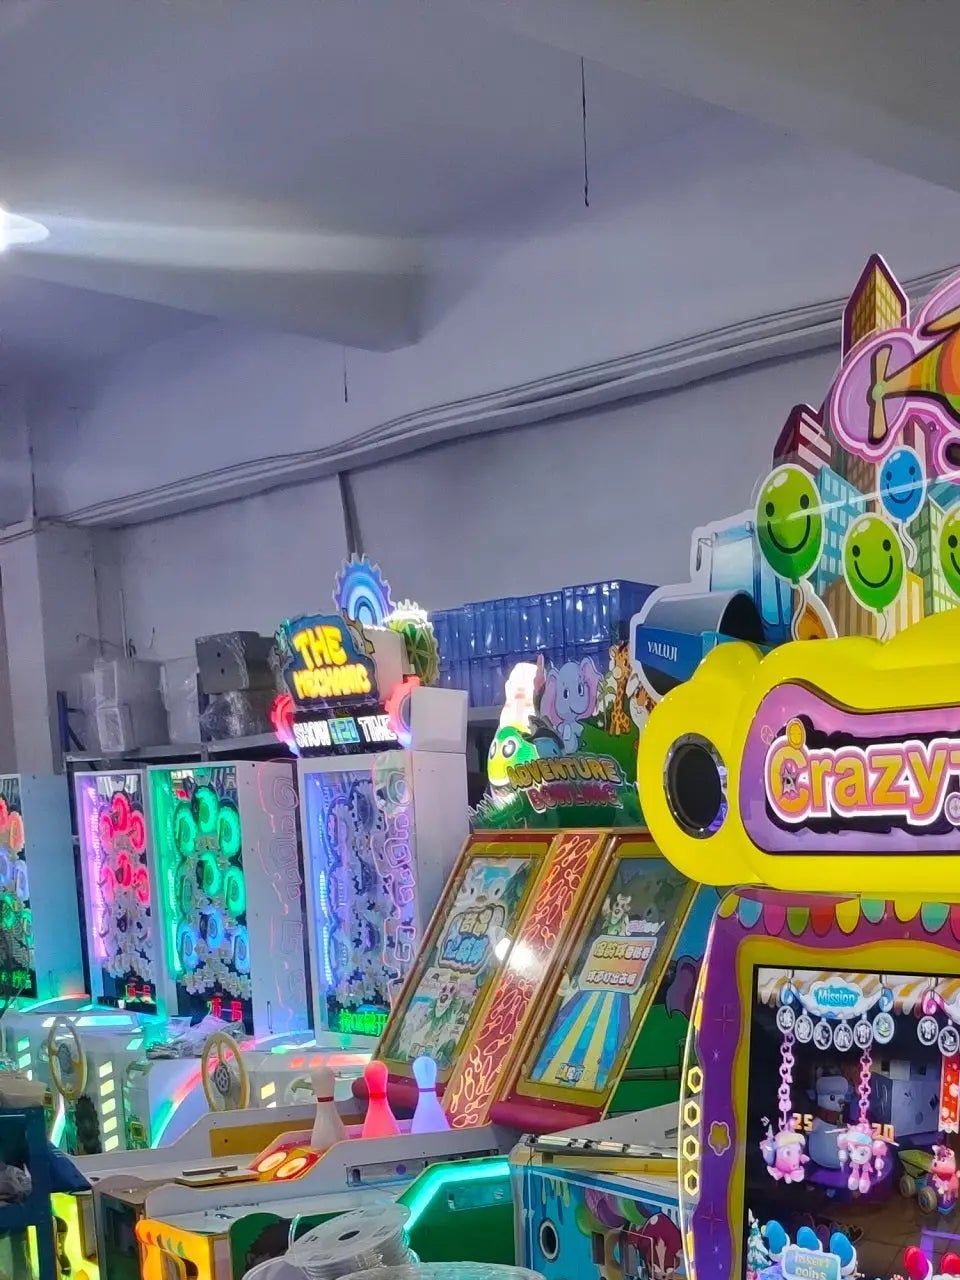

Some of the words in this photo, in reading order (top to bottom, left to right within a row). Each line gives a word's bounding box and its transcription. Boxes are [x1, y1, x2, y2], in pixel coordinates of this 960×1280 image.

[292, 625, 347, 670] THE
[646, 640, 679, 661] YALUJI
[293, 719, 332, 748] SHOW
[507, 756, 621, 790] ADVENTURE
[526, 783, 623, 811] BOWLING
[817, 989, 856, 1007] Mission
[792, 1113, 813, 1131] 25
[871, 1123, 895, 1142] 20
[793, 1254, 830, 1270] Insert
[795, 1265, 828, 1280] coins
